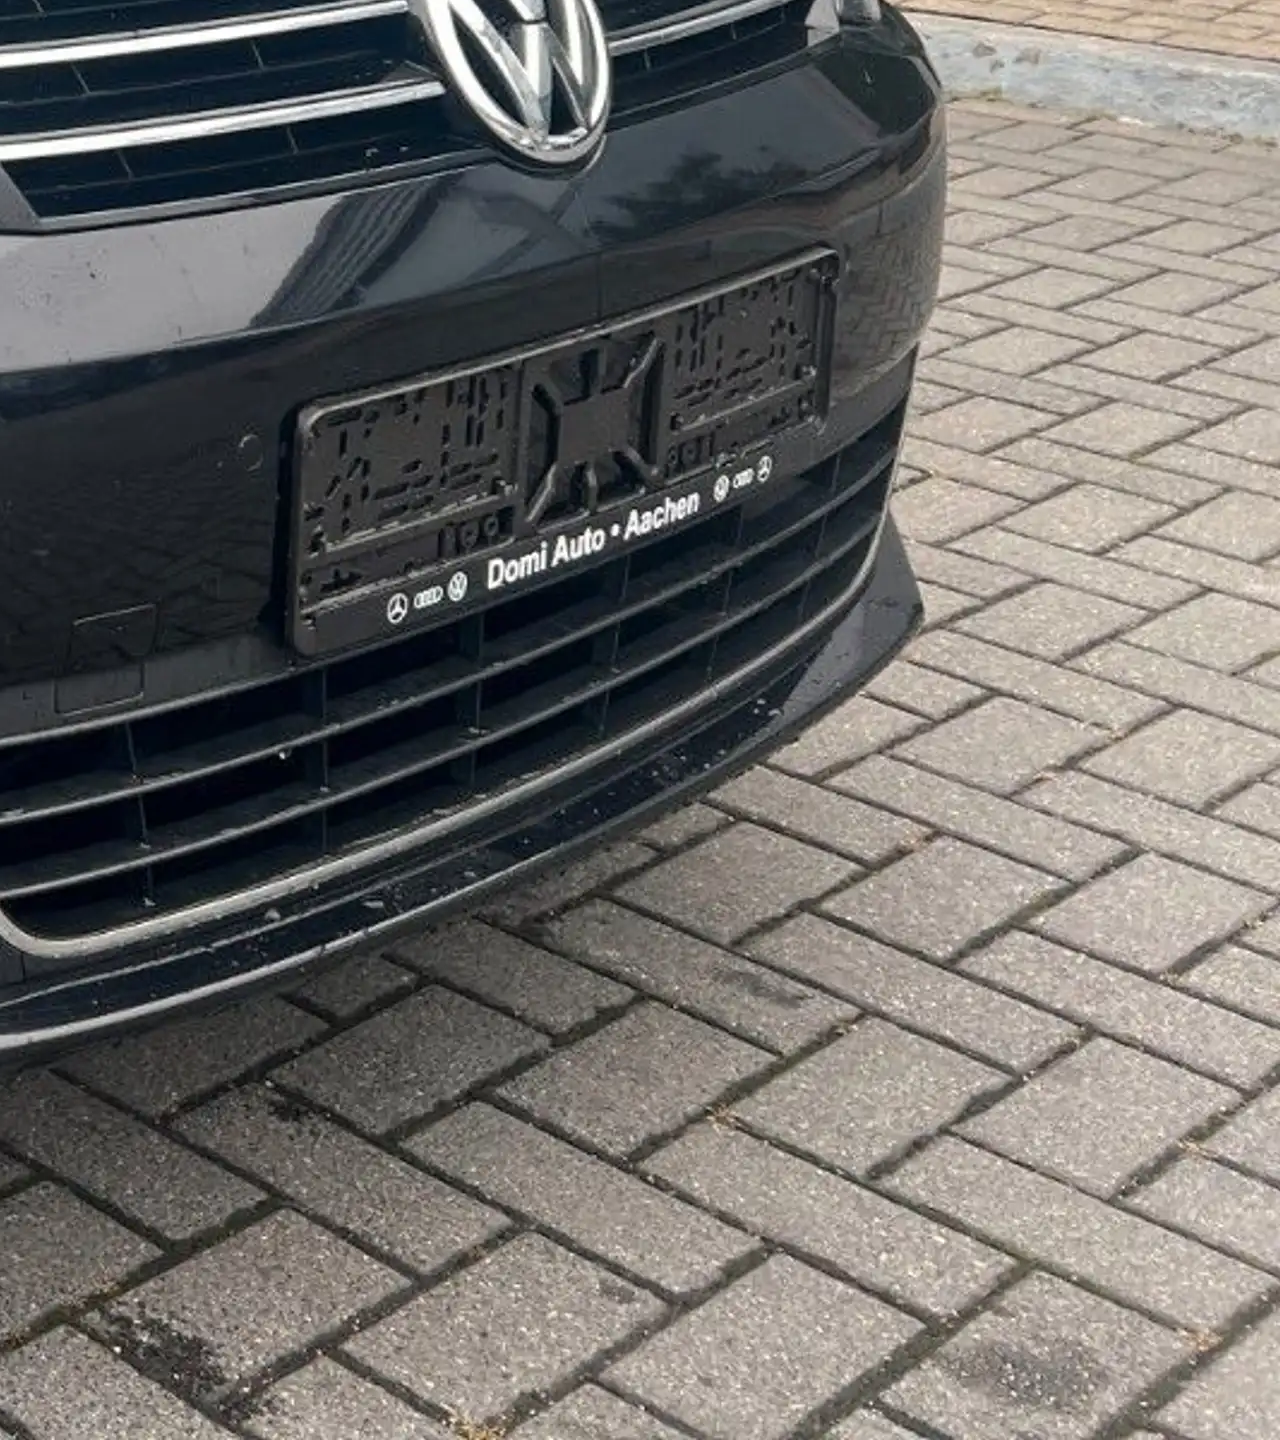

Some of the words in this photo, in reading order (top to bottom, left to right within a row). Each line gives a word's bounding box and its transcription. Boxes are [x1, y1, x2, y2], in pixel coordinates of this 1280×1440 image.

[487, 541, 547, 590] Domi
[551, 527, 605, 566] Auto
[623, 492, 701, 540] Aachen
